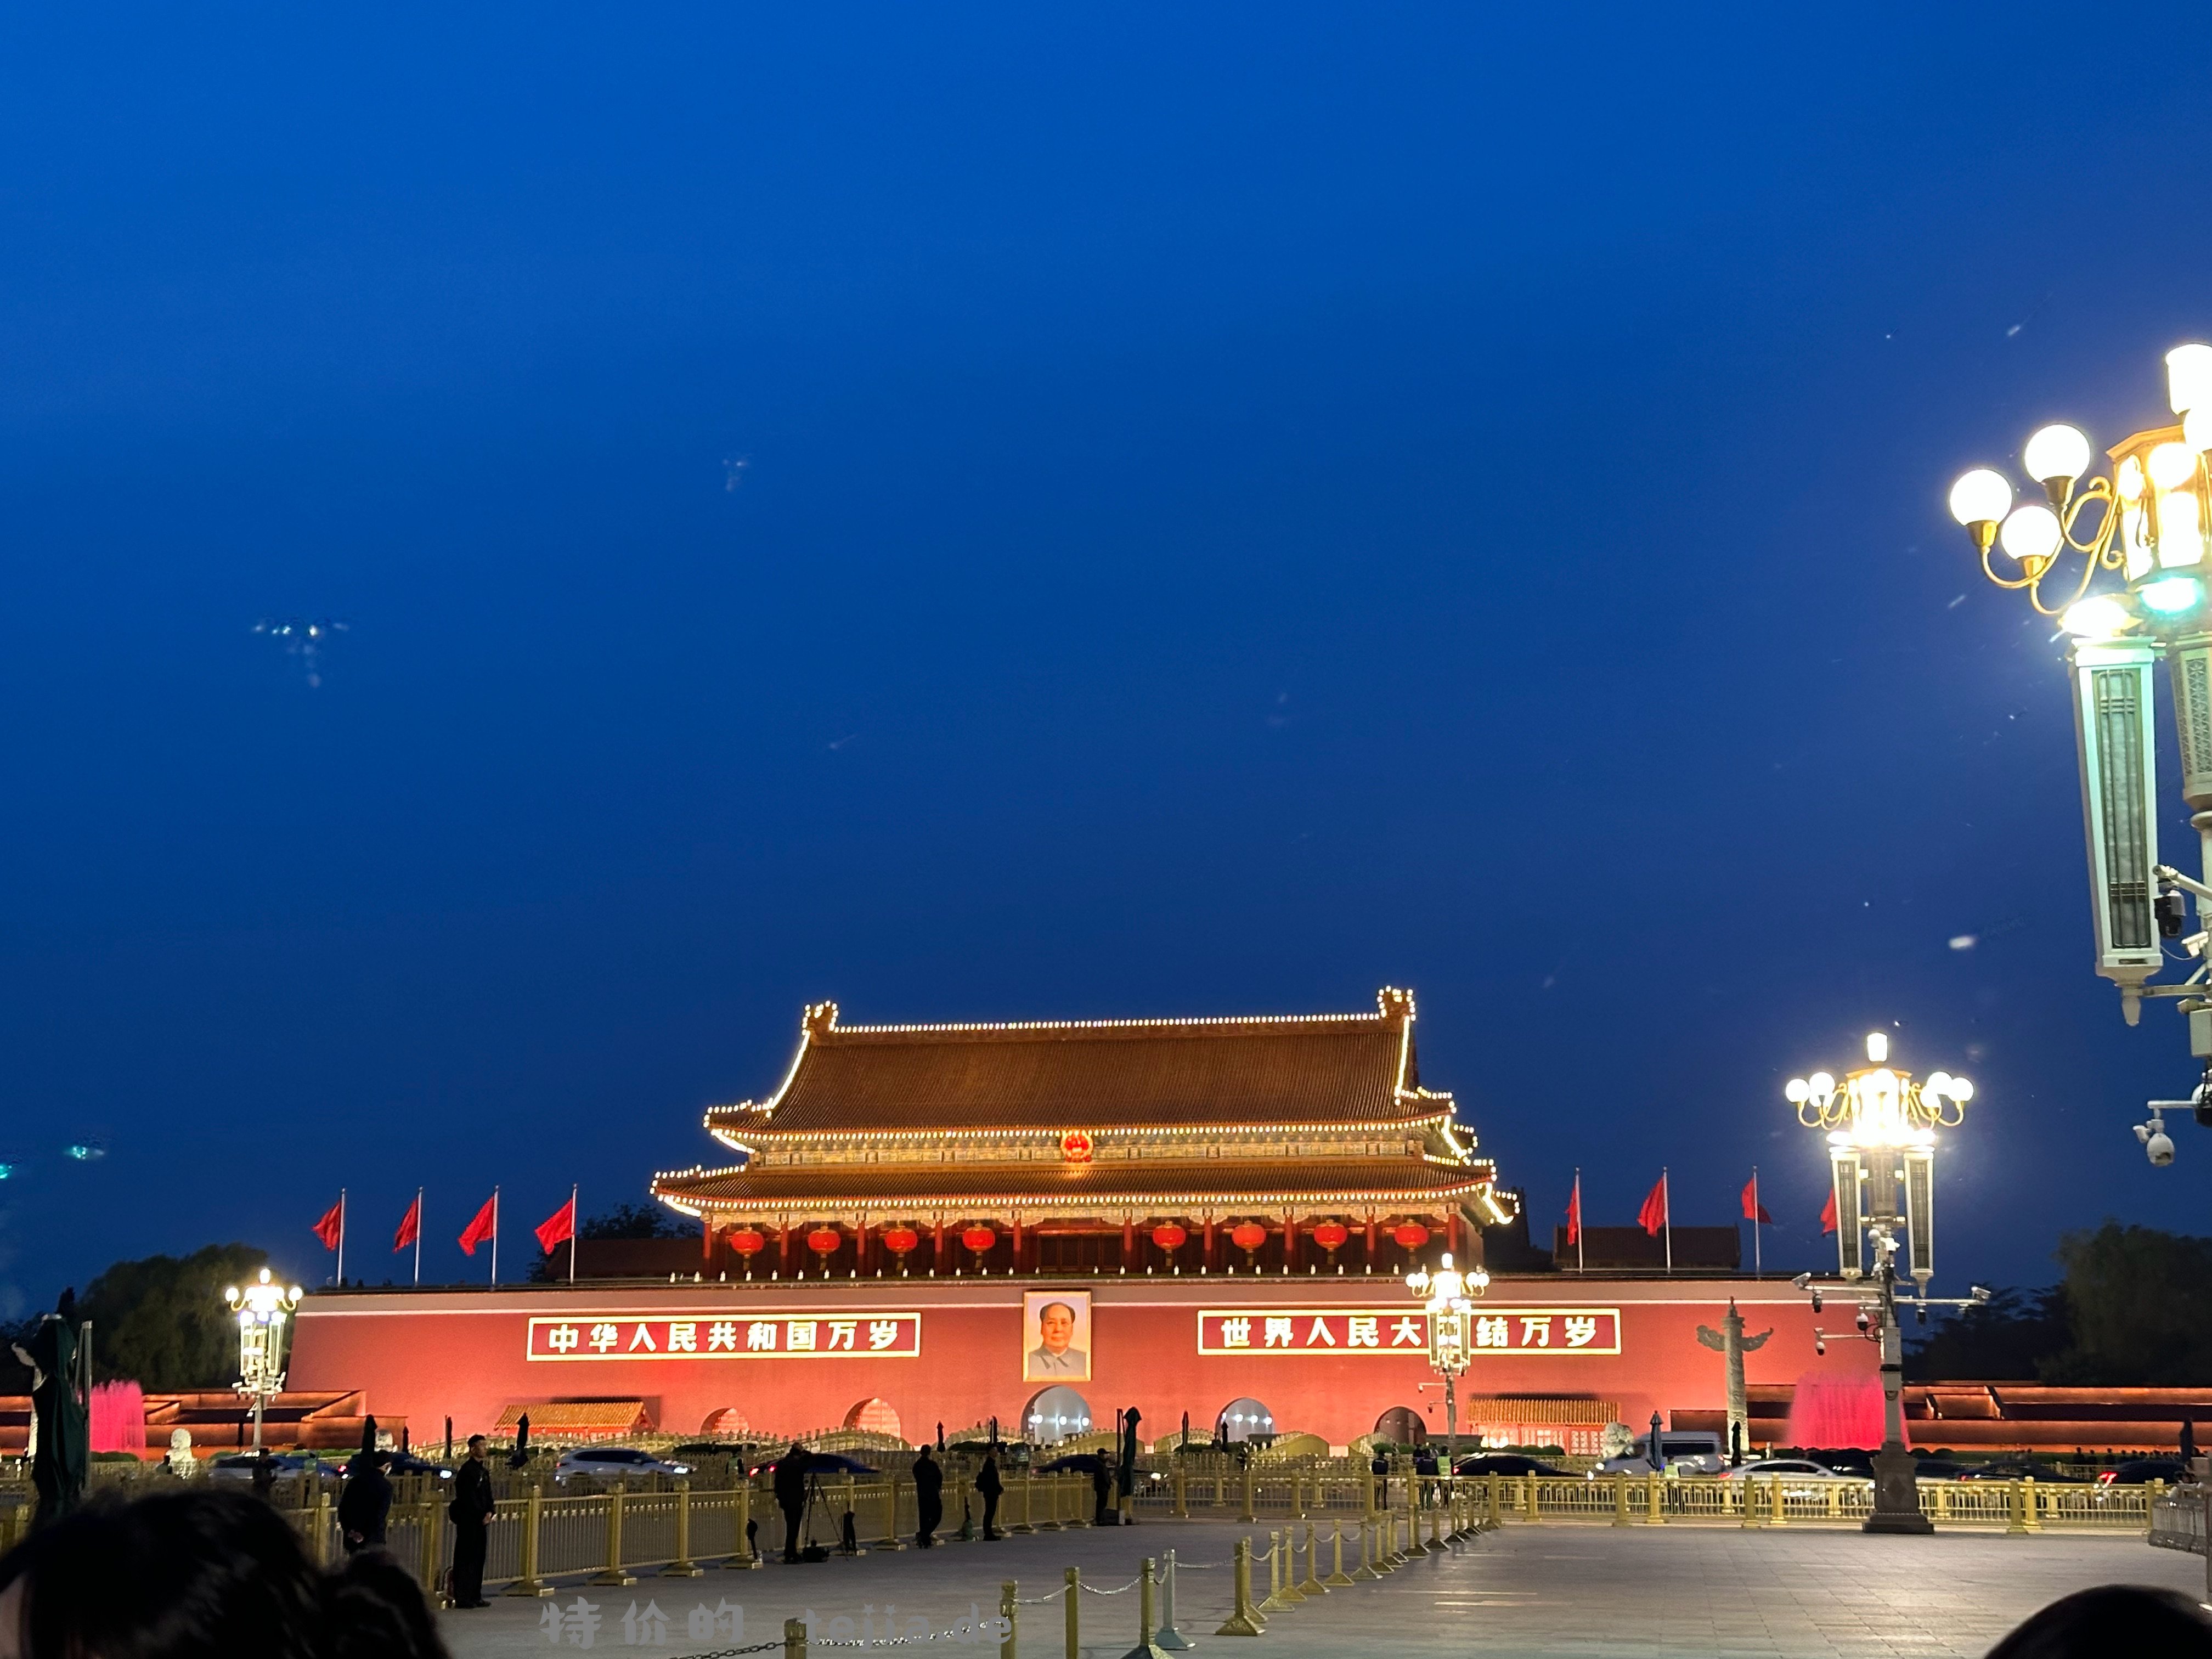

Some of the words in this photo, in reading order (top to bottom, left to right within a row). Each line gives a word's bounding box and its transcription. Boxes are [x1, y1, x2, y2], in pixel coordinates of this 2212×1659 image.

[548, 1320, 898, 1353] 中华人民共和国万岁
[1221, 1316, 1597, 1348] 世界人民大结万岁
